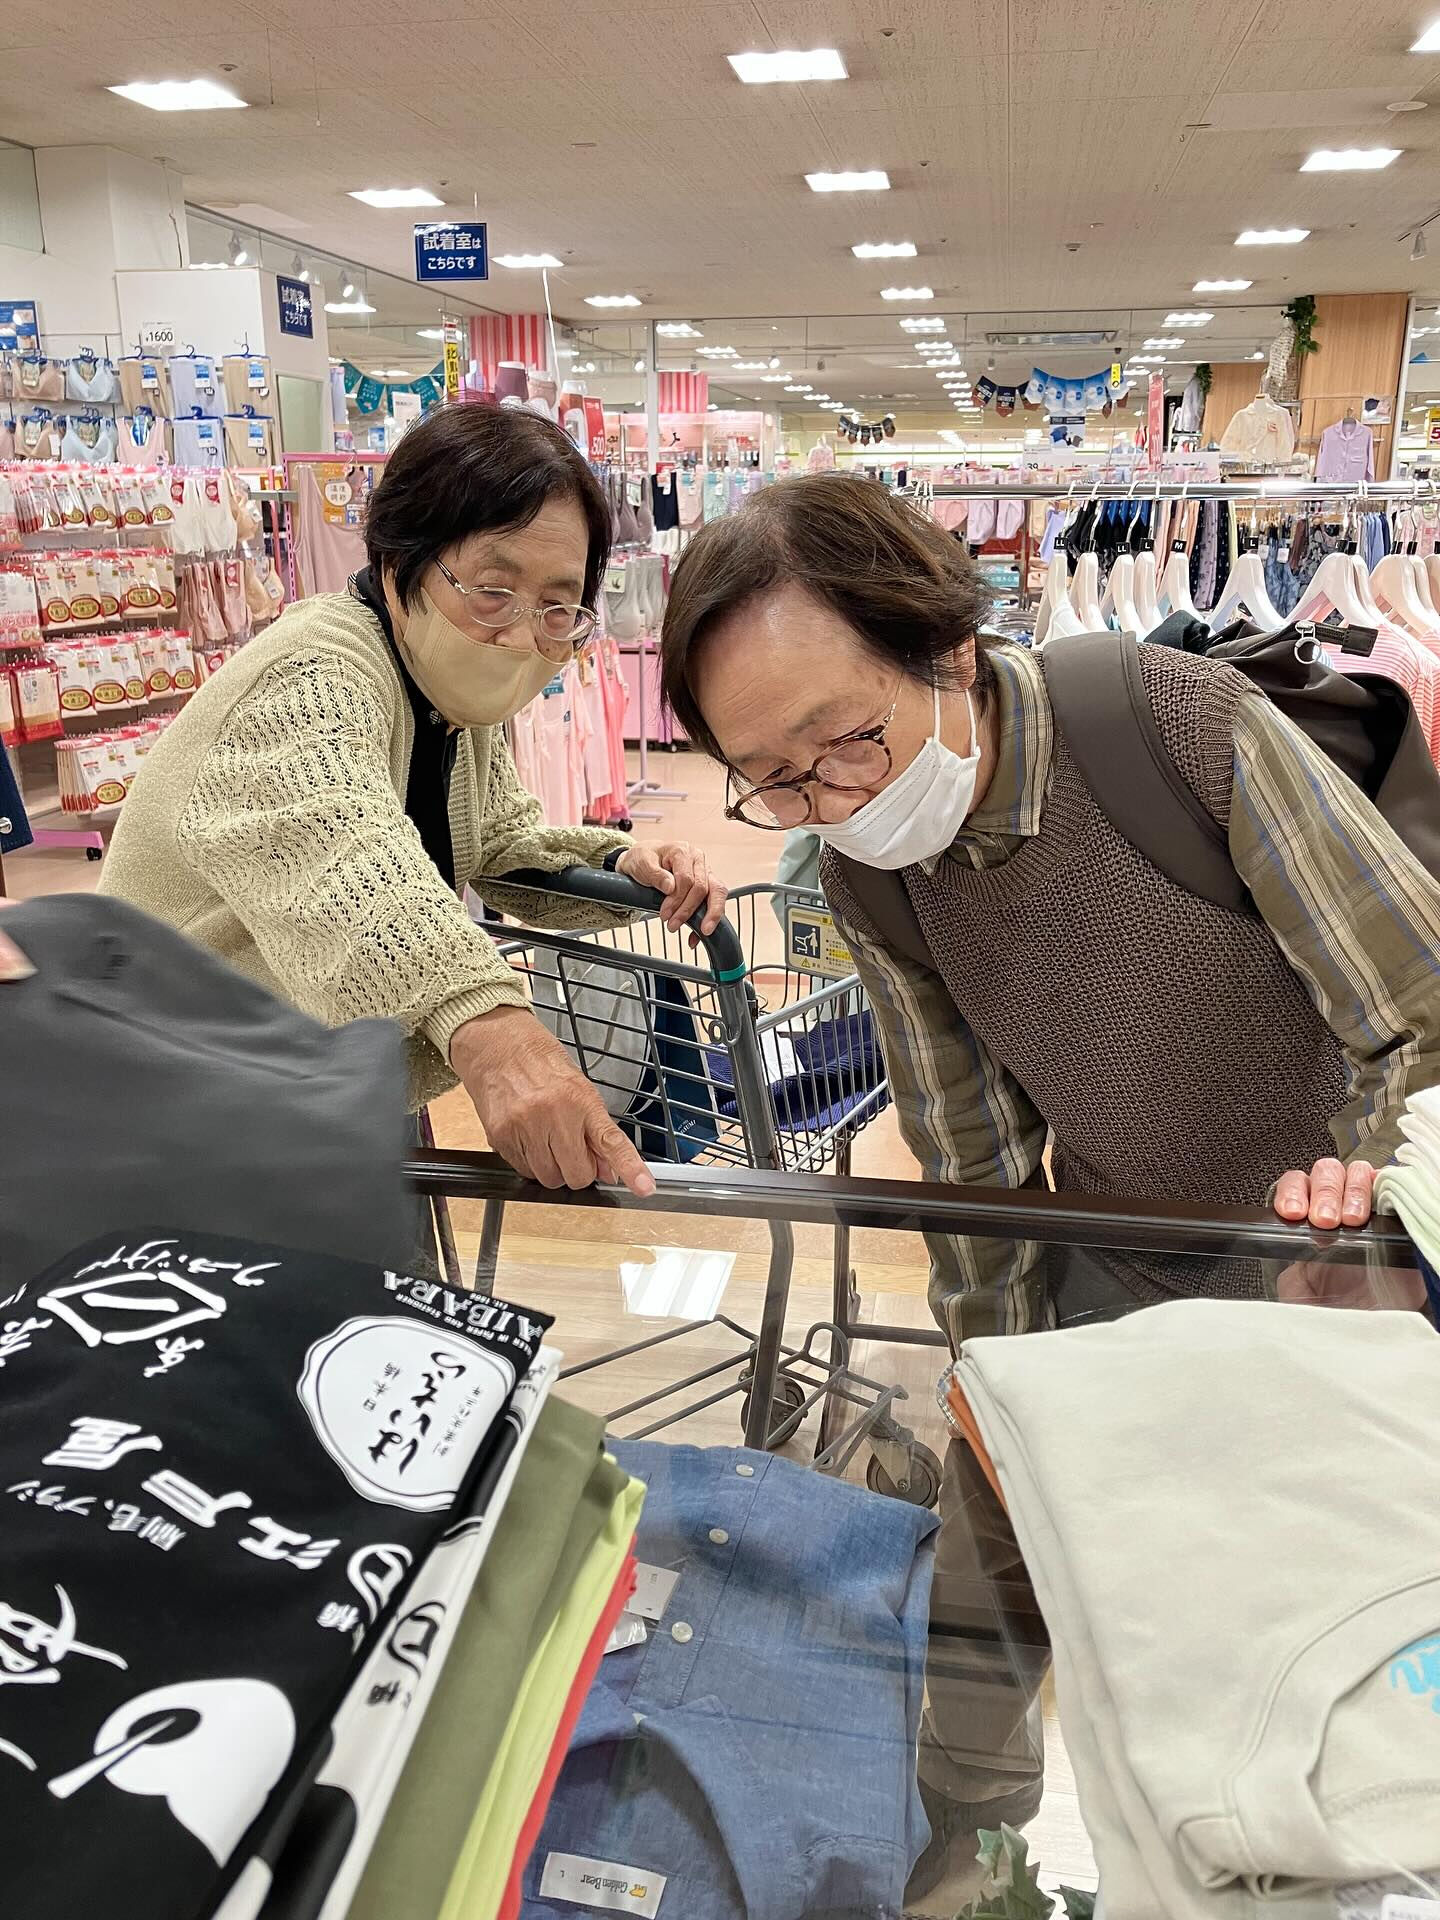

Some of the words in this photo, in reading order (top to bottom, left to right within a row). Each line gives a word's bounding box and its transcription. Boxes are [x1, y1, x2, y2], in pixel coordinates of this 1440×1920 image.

[423, 232, 482, 251] 試着室は
[427, 256, 477, 270] こちらです
[41, 1416, 341, 1570] 江戸屋
[580, 1874, 602, 1890] Bear
